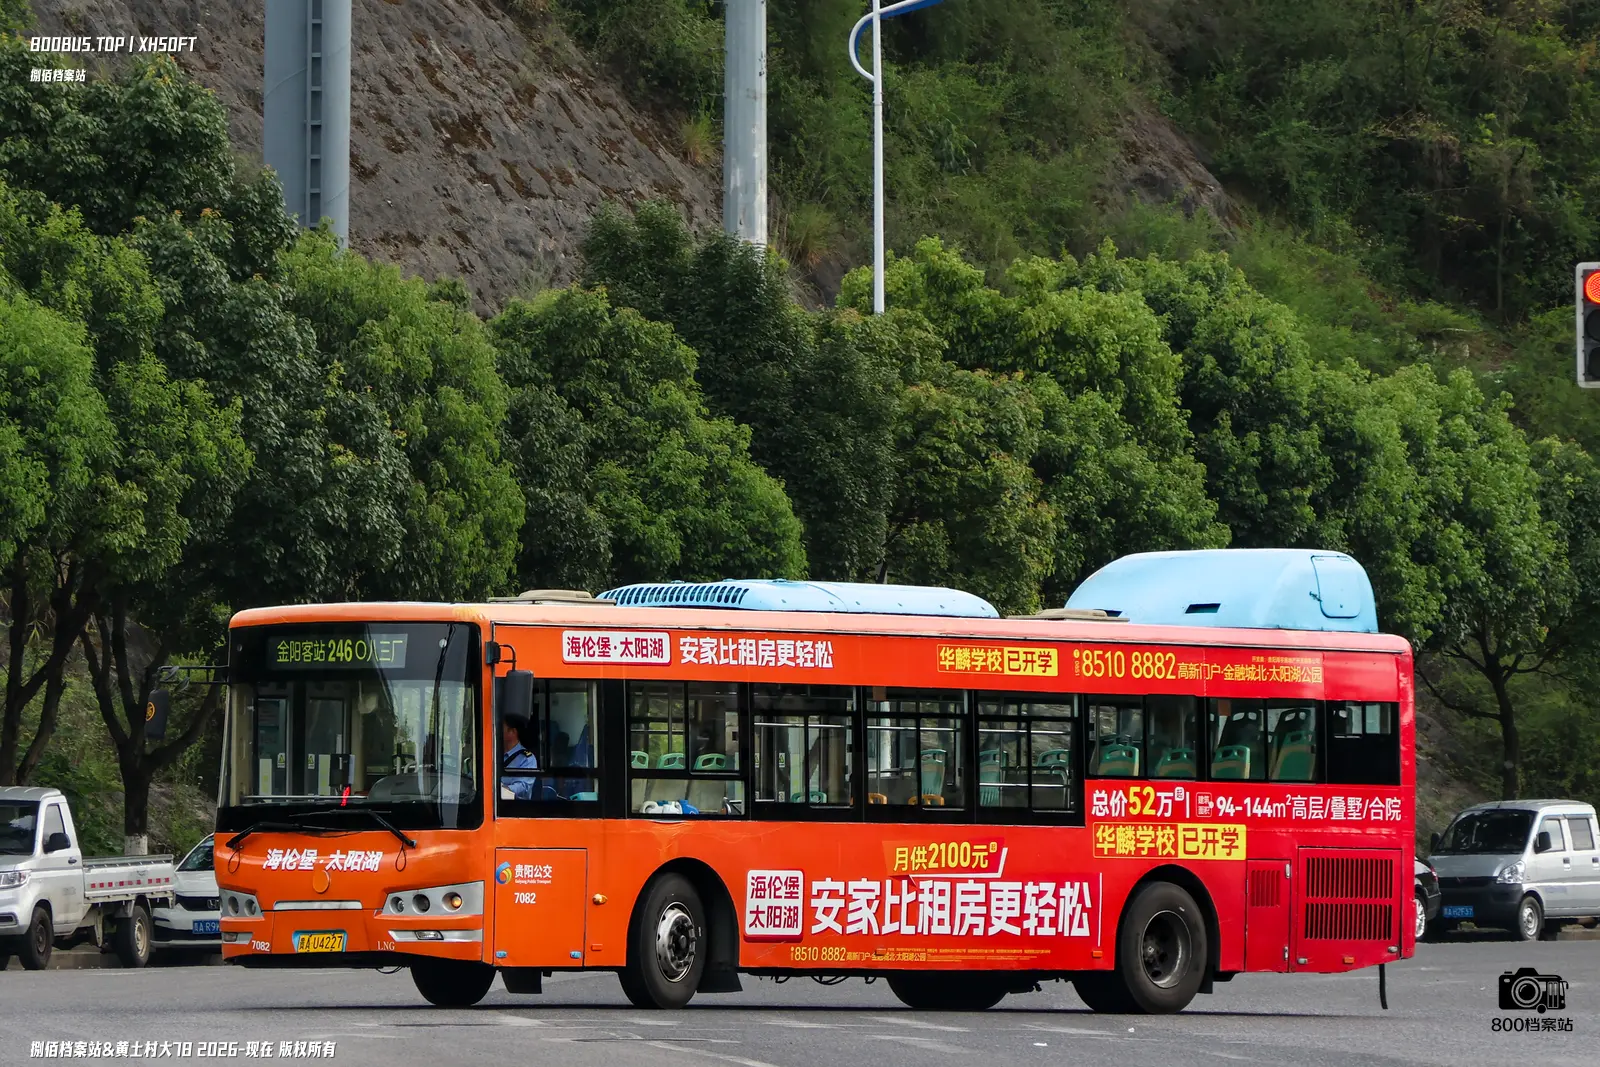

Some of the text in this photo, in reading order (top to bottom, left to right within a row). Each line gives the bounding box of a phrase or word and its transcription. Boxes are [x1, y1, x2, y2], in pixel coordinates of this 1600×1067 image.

[276, 639, 326, 663] 金阳客站
[327, 638, 353, 662] 246
[566, 635, 834, 668] 海伦堡·太阳湖 安家比租房更轻松
[1081, 649, 1126, 678] 8510
[1131, 651, 1176, 680] 8882
[262, 848, 384, 872] 海伦堡·太阳湖
[514, 863, 553, 879] 贵阳公交
[514, 892, 536, 904] 7082
[750, 875, 801, 900] 海伦堡
[748, 904, 799, 929] 太阳湖
[810, 877, 1092, 937] 安家比租房更轻松
[251, 940, 271, 951] 7082
[377, 940, 396, 951] LNG
[794, 946, 819, 961] 8510
[821, 947, 846, 962] 8882
